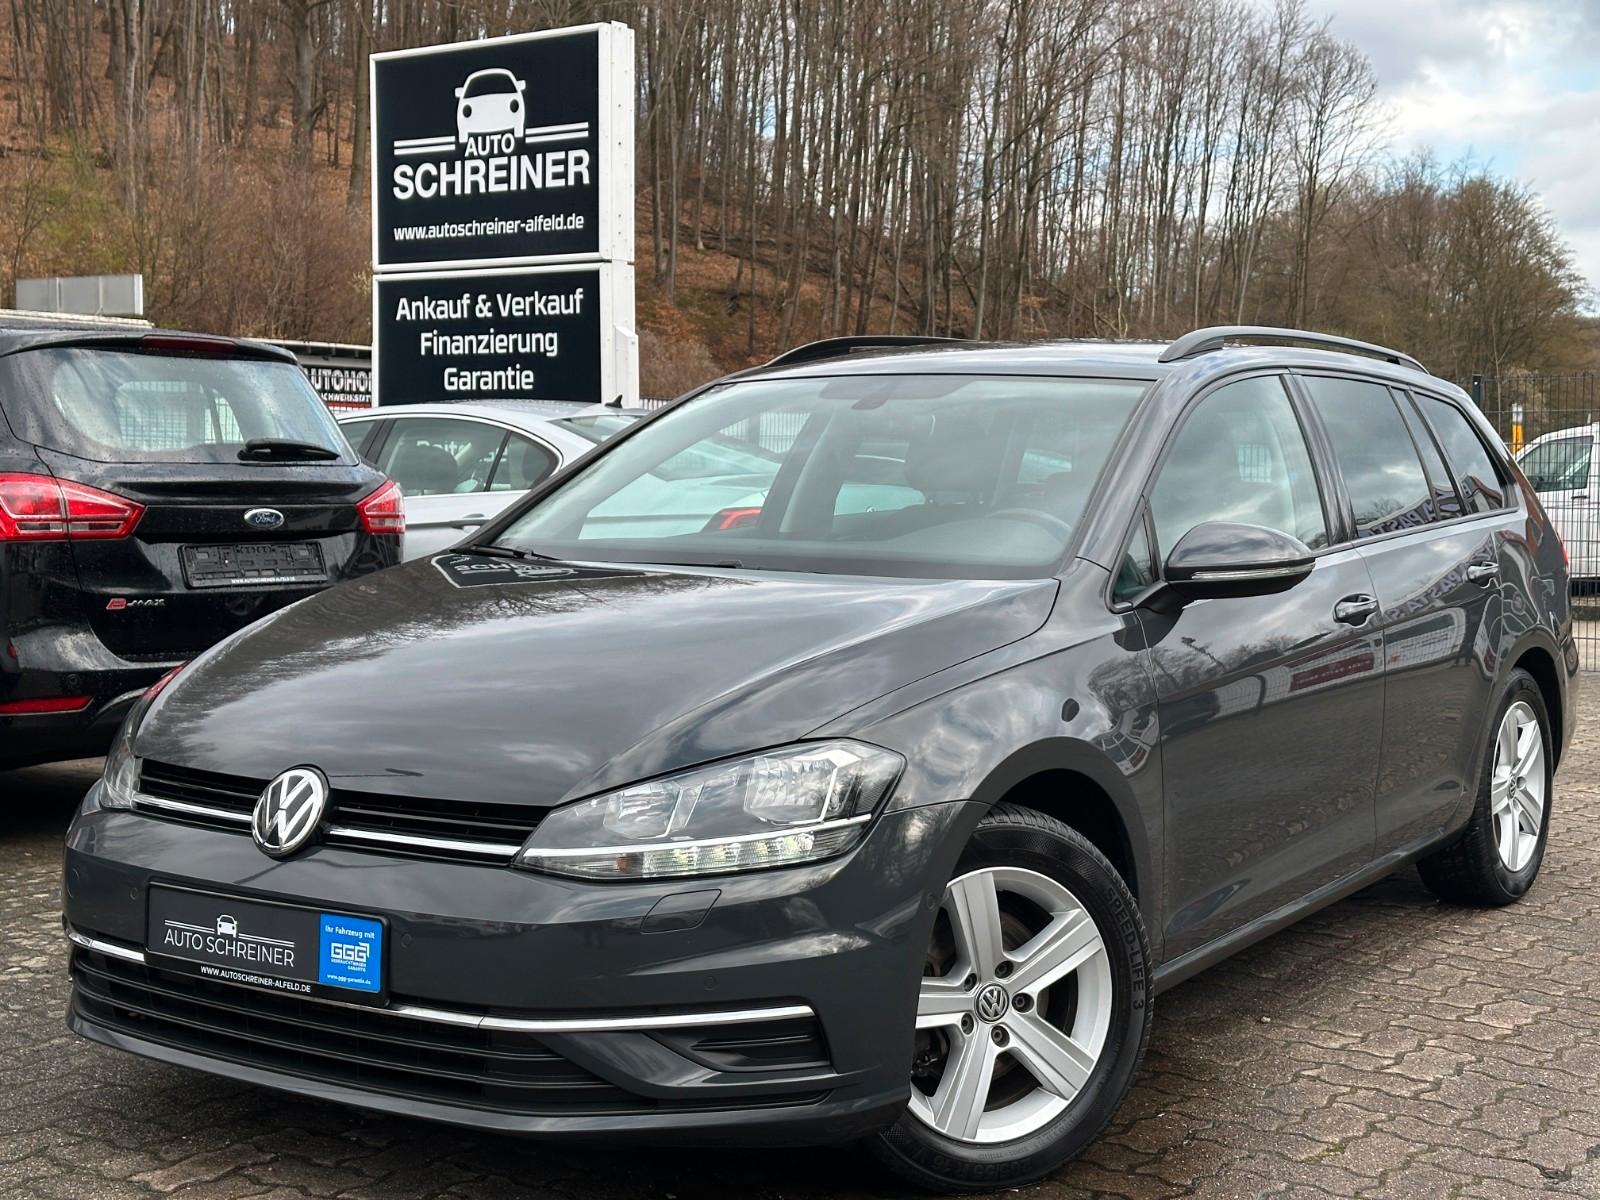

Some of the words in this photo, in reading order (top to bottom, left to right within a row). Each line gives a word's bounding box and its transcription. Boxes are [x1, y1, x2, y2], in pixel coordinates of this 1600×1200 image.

[465, 133, 515, 157] AUTO
[393, 149, 590, 199] SCHREINER
[394, 213, 584, 241] www.autoschreiner-alfeld.de
[396, 293, 471, 321] Ankauf
[475, 296, 493, 318] &
[497, 288, 584, 317] Verkauf
[420, 327, 558, 357] Finanzierung
[303, 368, 372, 392] UTOHO
[444, 364, 534, 391] Garantie
[335, 927, 362, 938] Fahrzeug
[364, 931, 375, 939] mit
[164, 928, 203, 950] AUTO
[206, 937, 295, 967] SCHREINER
[331, 942, 369, 962] GGG
[1104, 887, 1145, 992] SPEED-LIFE
[1132, 1001, 1144, 1011] 3
[201, 966, 311, 993] WWW.AUTOSCHREINER-ALFELD.DE
